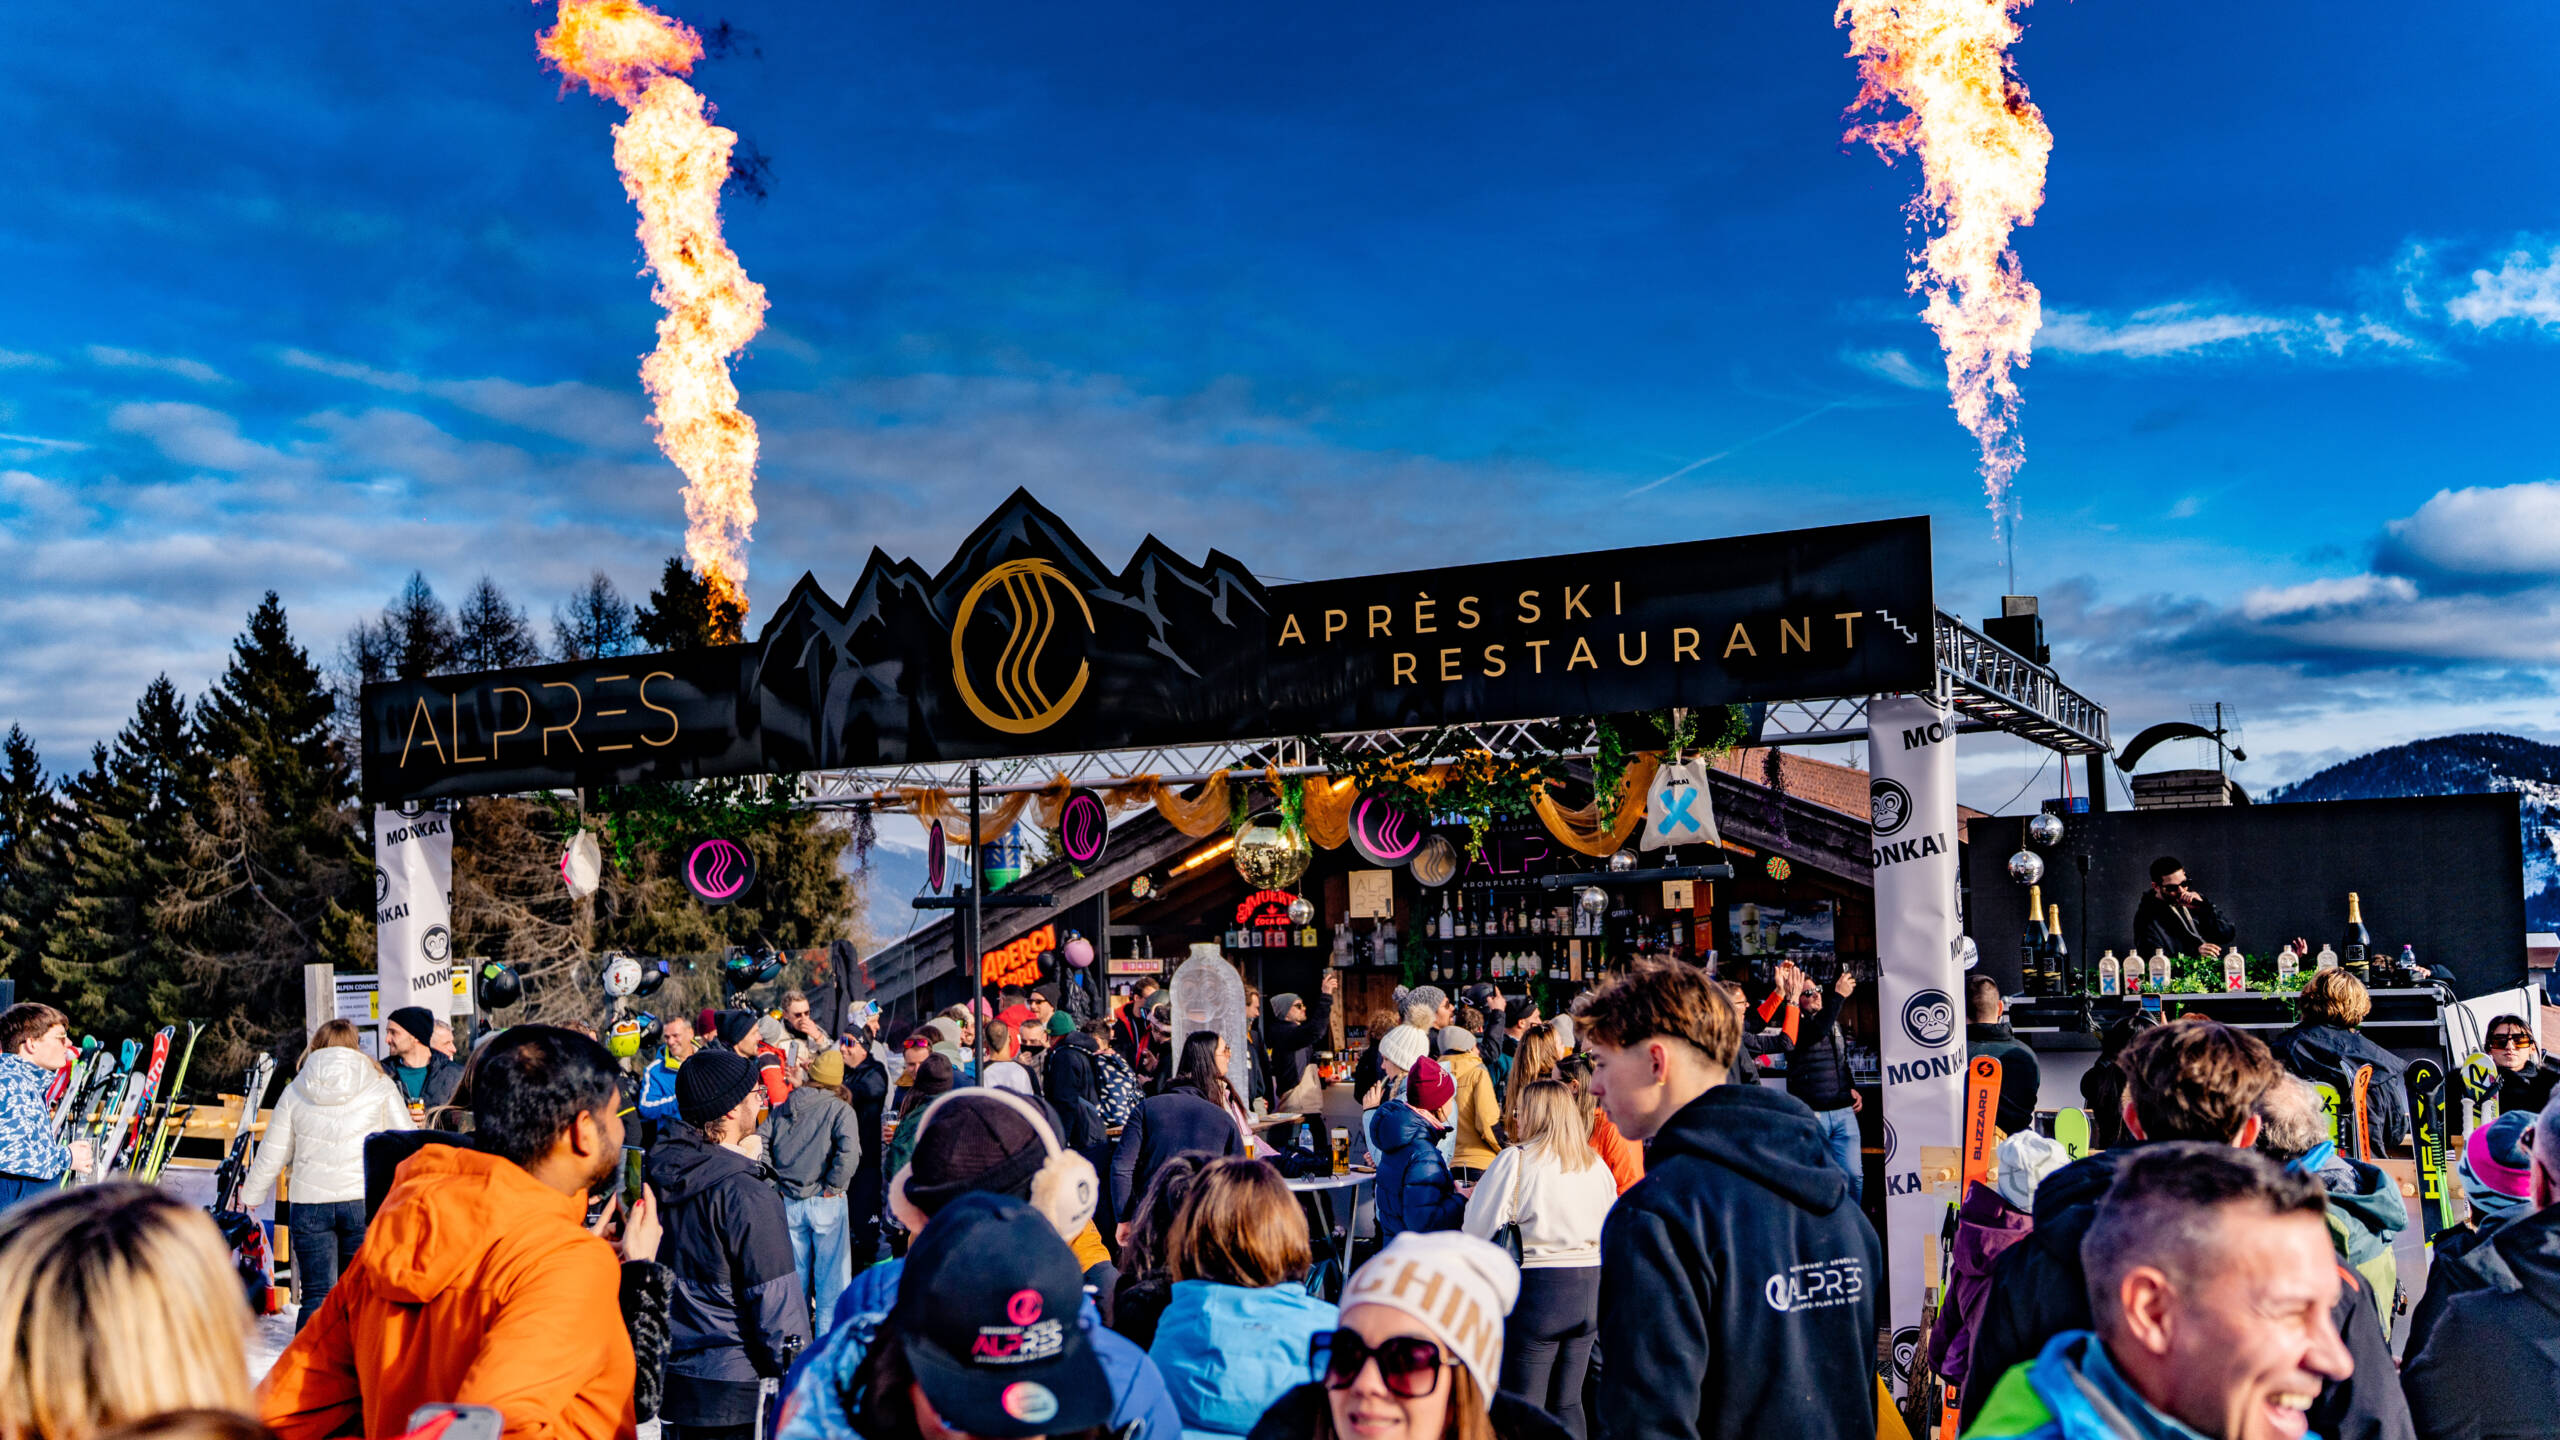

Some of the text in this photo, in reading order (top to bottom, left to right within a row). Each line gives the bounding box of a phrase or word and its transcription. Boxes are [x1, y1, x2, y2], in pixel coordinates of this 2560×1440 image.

[1277, 580, 1623, 648] APRÈS SKI
[1392, 612, 1863, 686] RESTAURANT
[399, 671, 679, 769] ALPRES
[386, 819, 446, 847] MONKAI
[1462, 876, 1545, 889] KRONPLATZ-P
[1236, 889, 1299, 924] AMUERT
[354, 983, 379, 991] CONNEC
[1887, 1045, 1965, 1085] MONKAI
[1973, 1089, 1988, 1160] BLIZZARD
